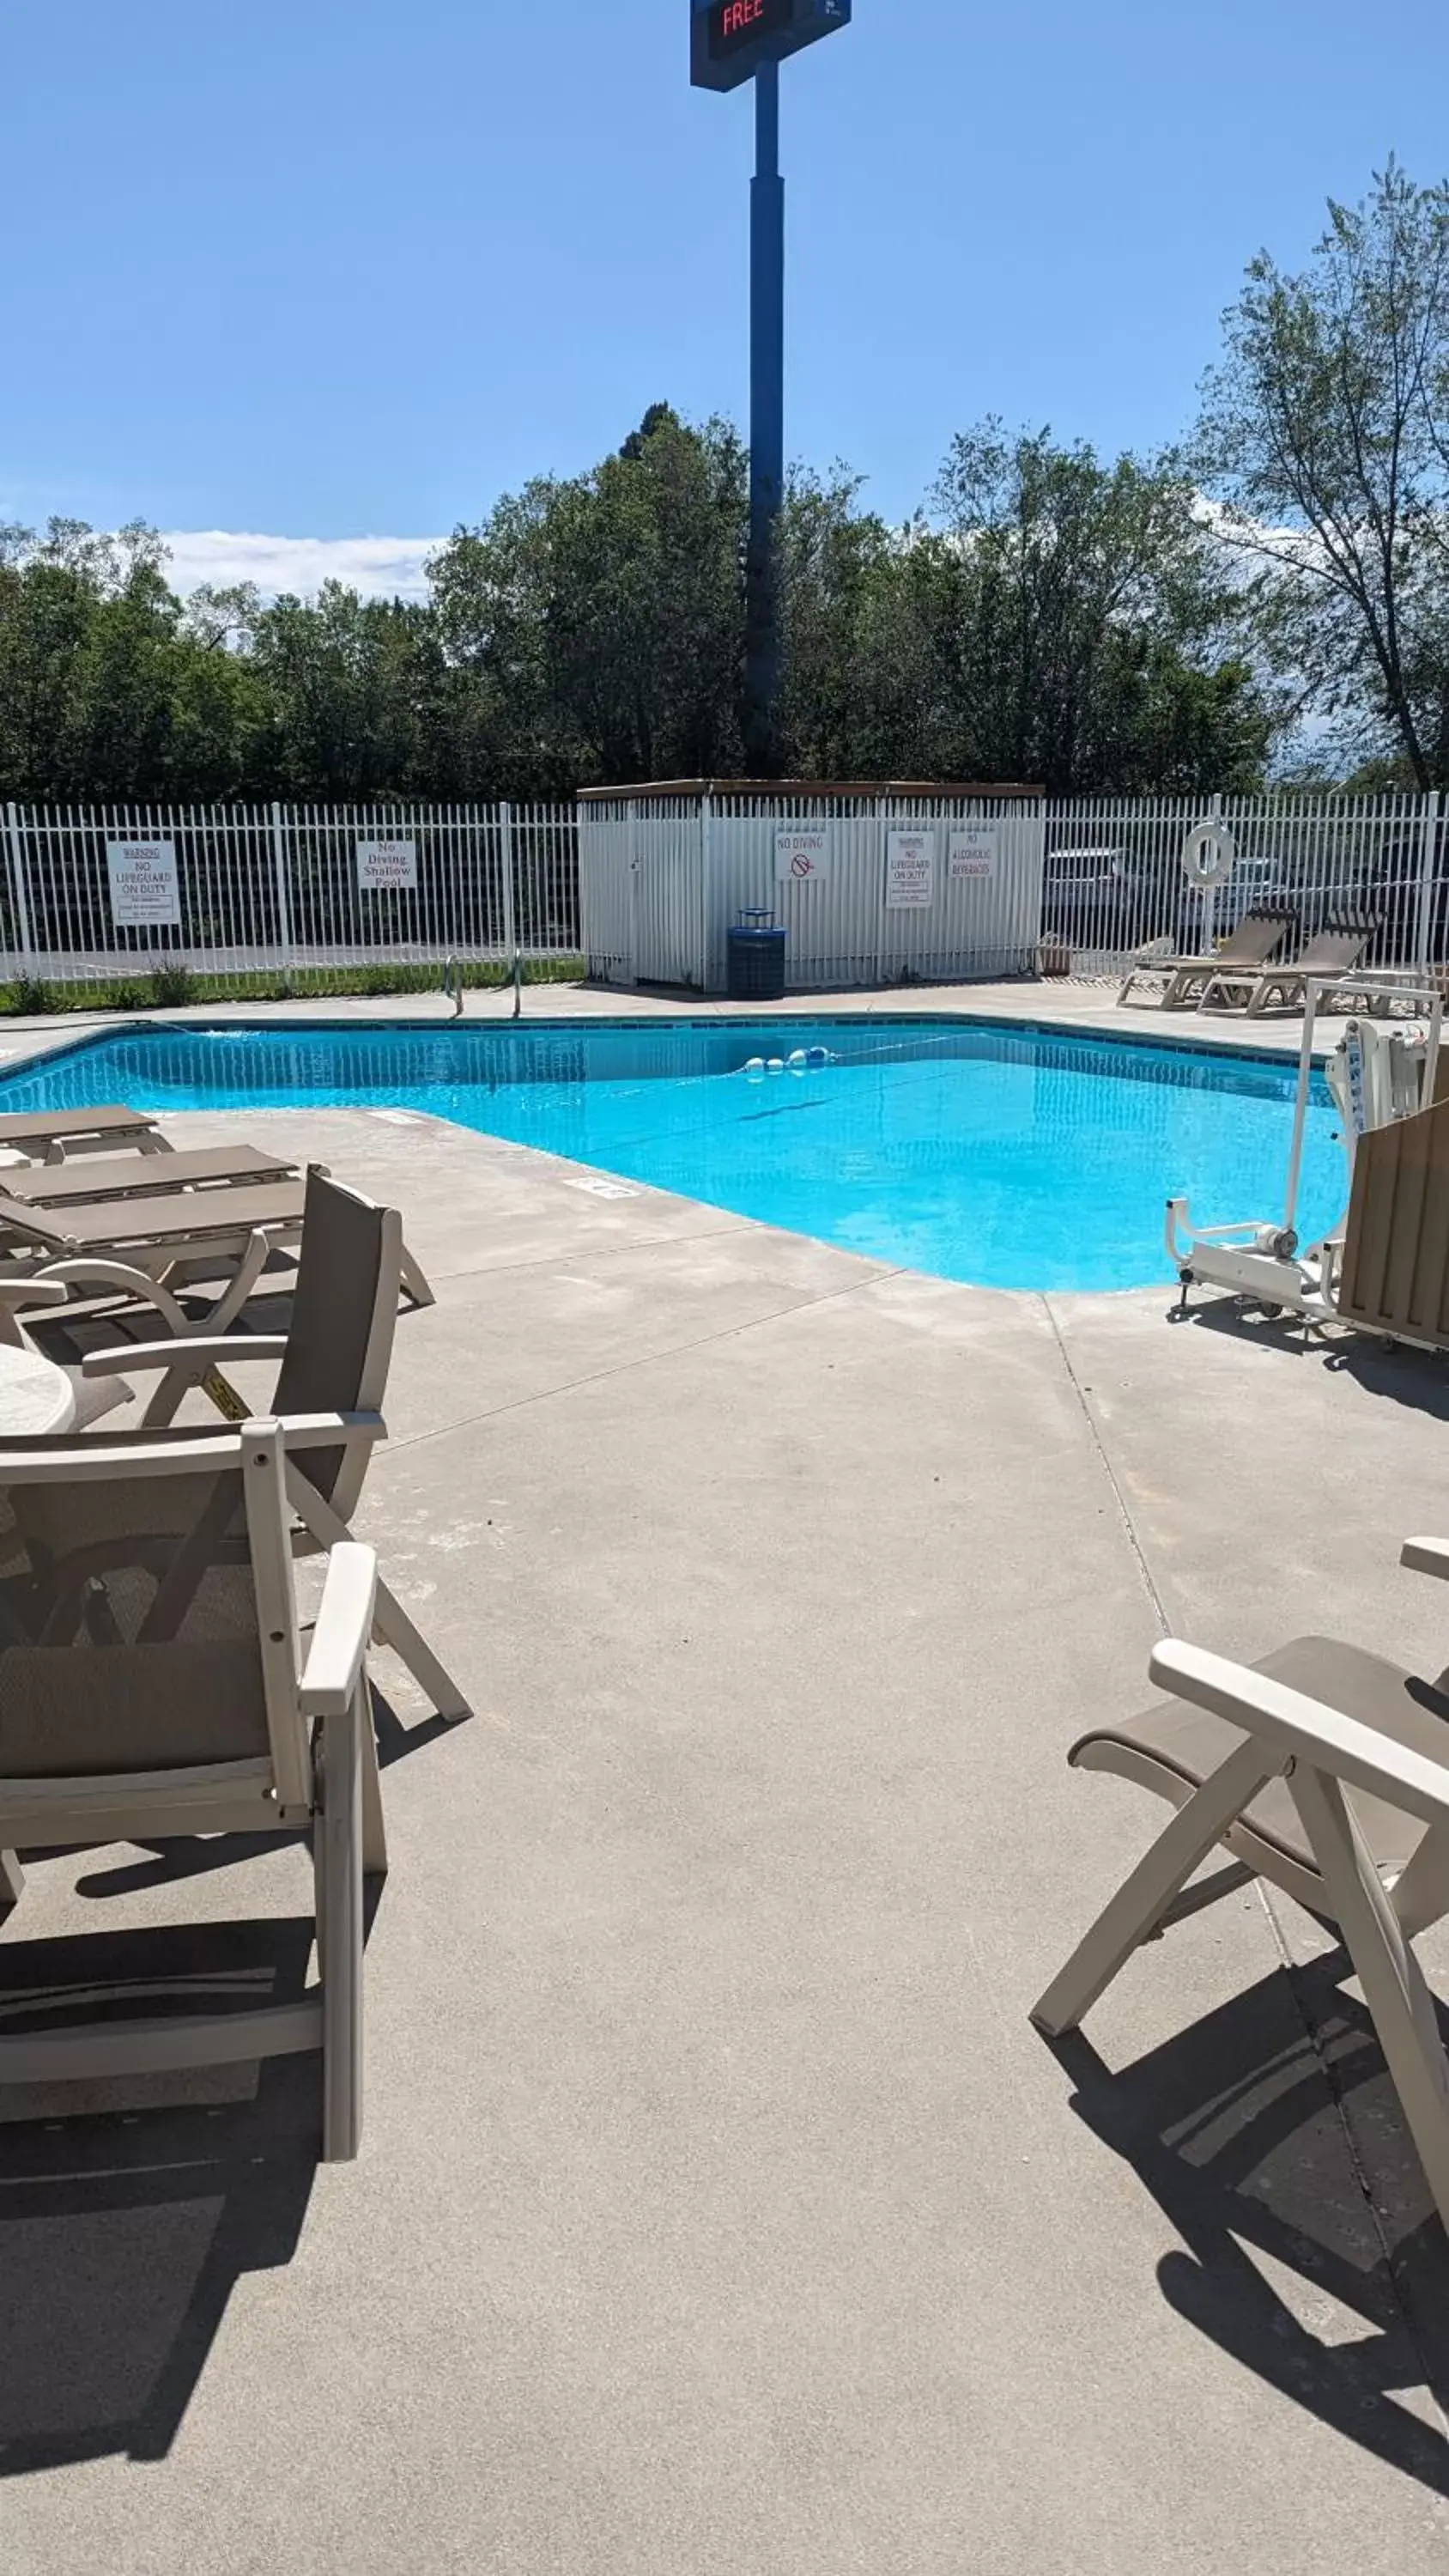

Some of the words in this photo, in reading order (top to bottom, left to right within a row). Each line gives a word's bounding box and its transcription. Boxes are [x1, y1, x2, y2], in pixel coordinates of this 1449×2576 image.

[723, 0, 763, 35] FREE
[379, 841, 395, 852] No
[778, 837, 791, 849] NO
[792, 836, 822, 849] DIVING
[124, 848, 160, 858] WARNING
[952, 849, 991, 860] ALCOHOLIC
[368, 854, 407, 866] Diving
[891, 860, 931, 870] LIFEGUARD
[136, 862, 151, 871] NO
[364, 866, 410, 877] Shallow
[116, 872, 172, 884] LIFEGUARD
[894, 871, 906, 879] ON
[907, 871, 926, 879] DUTY
[375, 878, 401, 887] Pool
